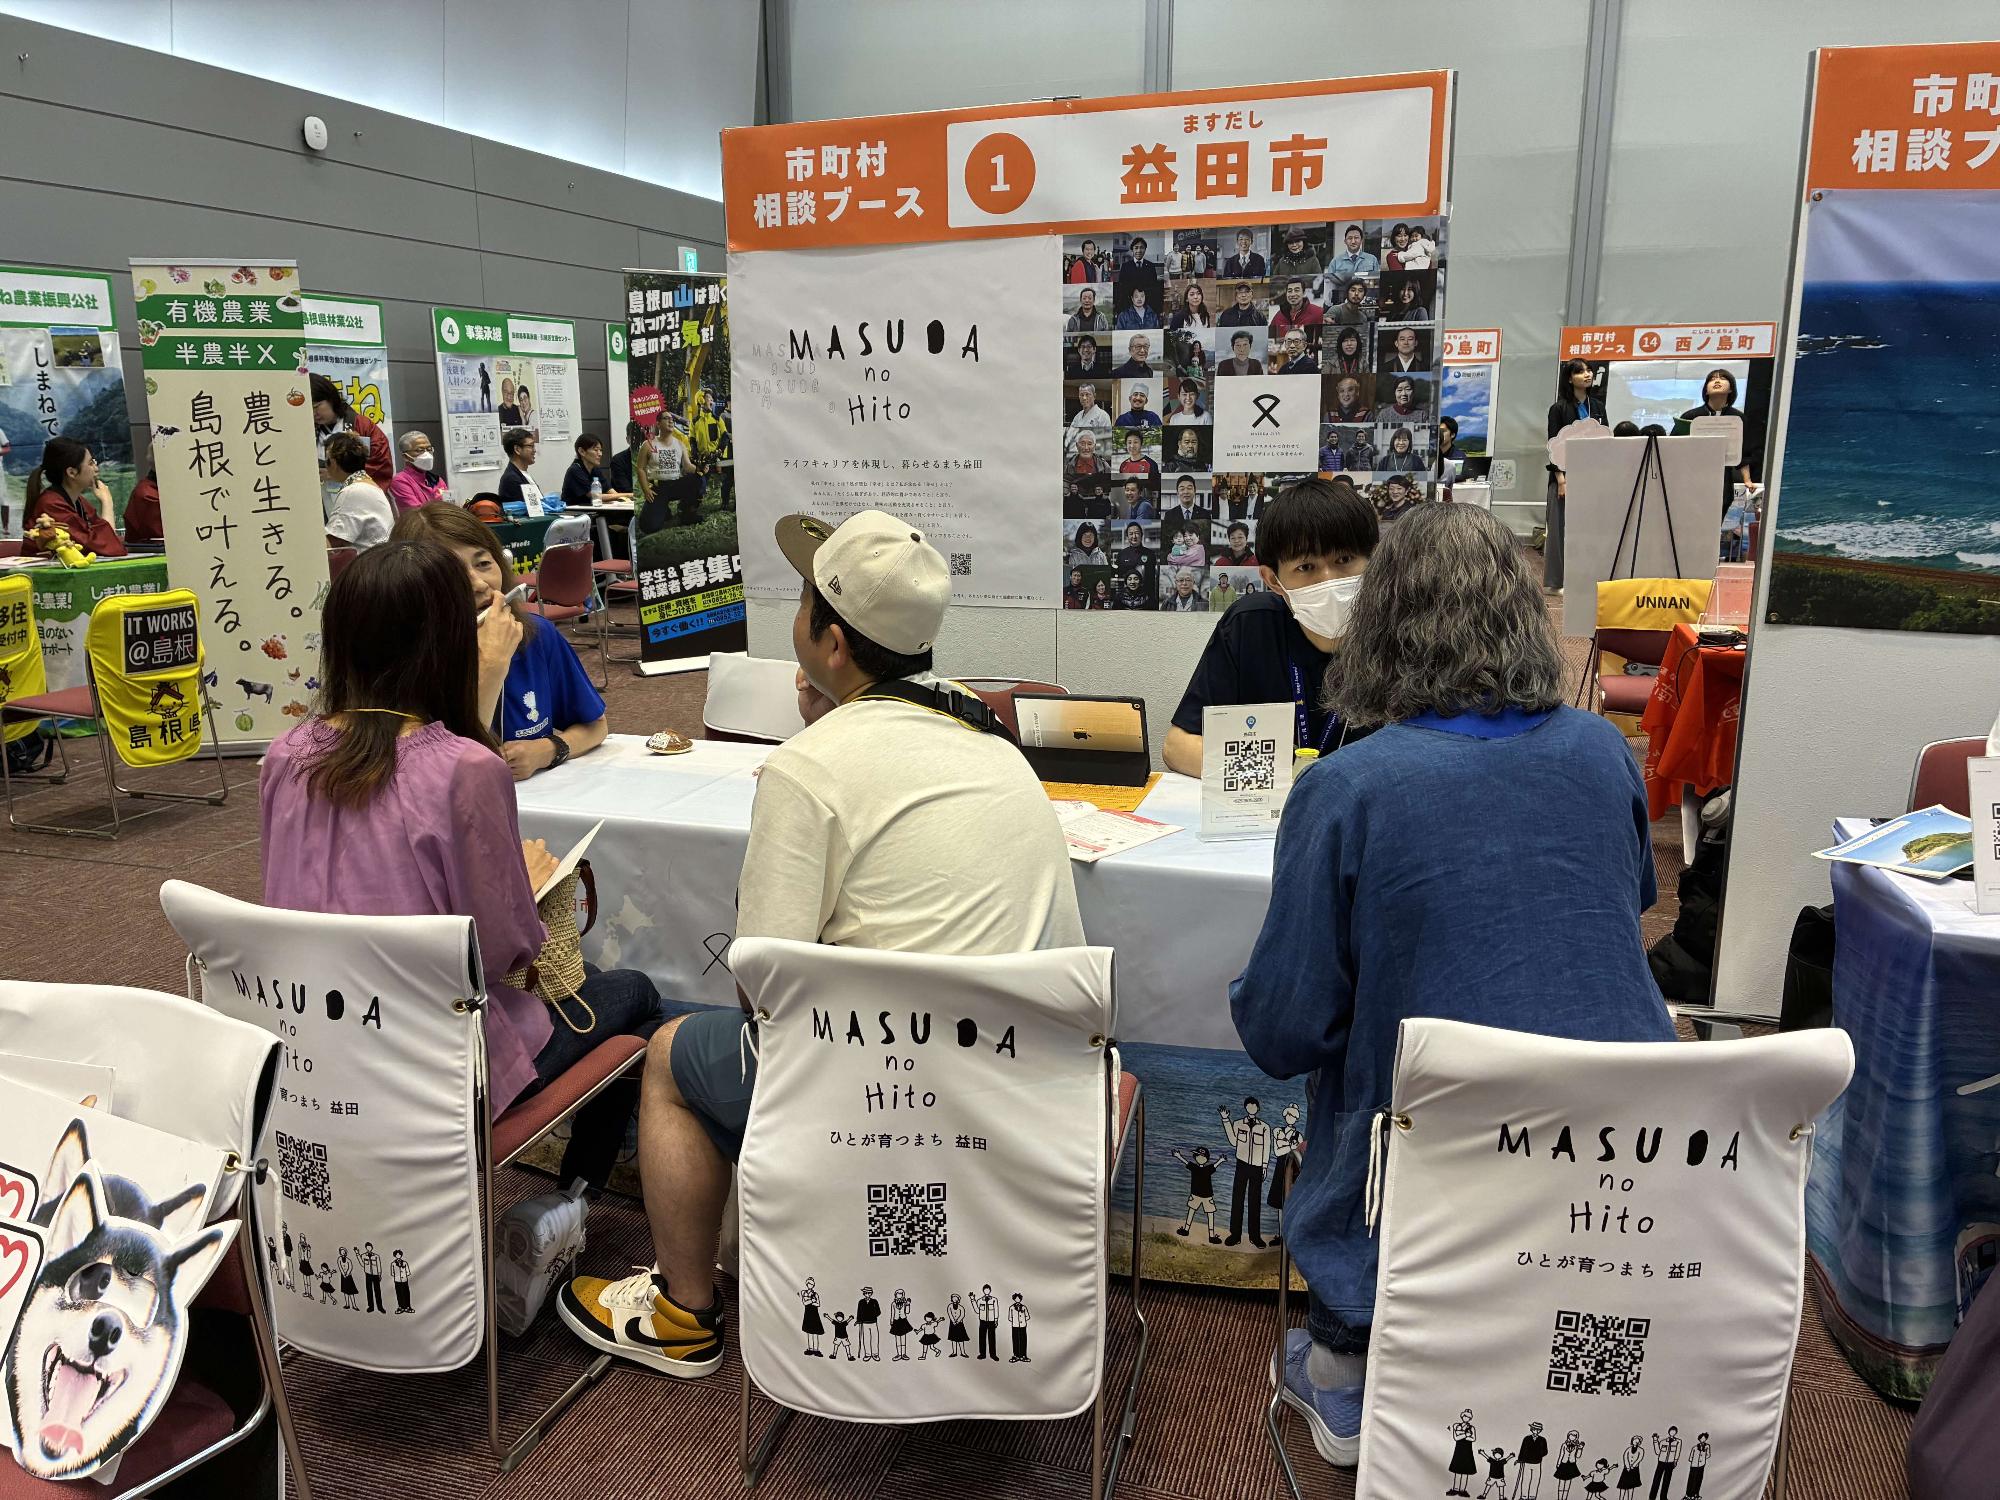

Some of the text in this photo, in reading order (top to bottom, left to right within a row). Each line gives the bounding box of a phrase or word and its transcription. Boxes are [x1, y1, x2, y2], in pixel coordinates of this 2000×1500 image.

[1183, 111, 1264, 134] ますだし
[785, 142, 888, 183] 市町村
[988, 153, 1011, 193] 1
[1121, 133, 1328, 205] 益田市
[753, 186, 925, 229] 相談ブース
[165, 299, 273, 325] 有機農業
[446, 324, 455, 337] 4
[788, 318, 980, 363] MASUDA
[1582, 331, 1616, 343] 市町村
[1642, 337, 1658, 348] 14
[1675, 335, 1756, 352] 西ノ島町
[1569, 344, 1626, 355] 相談ブース
[864, 366, 891, 382] no
[34, 347, 60, 444] しまねで
[848, 394, 911, 426] Hito
[242, 390, 303, 618] 農と生きる。
[188, 389, 251, 651] 島根で叶える。
[1635, 595, 1691, 610] UNNAN
[126, 609, 194, 635] IT WORKS
[128, 633, 195, 666] @島根
[231, 969, 382, 1030] MASUDA
[279, 1018, 297, 1037] no
[812, 1006, 1016, 1059] MASUDA
[285, 1045, 313, 1073] ito
[885, 1054, 915, 1071] no
[330, 1101, 359, 1116] 益田
[865, 1082, 936, 1113] Hito
[830, 1130, 988, 1151] ひとが育つまち 益田
[1497, 1122, 1741, 1172] MASUDA
[1599, 1173, 1634, 1192] no
[1569, 1200, 1654, 1234] Hito
[1517, 1251, 1702, 1279] ひとが育つまち 益田
